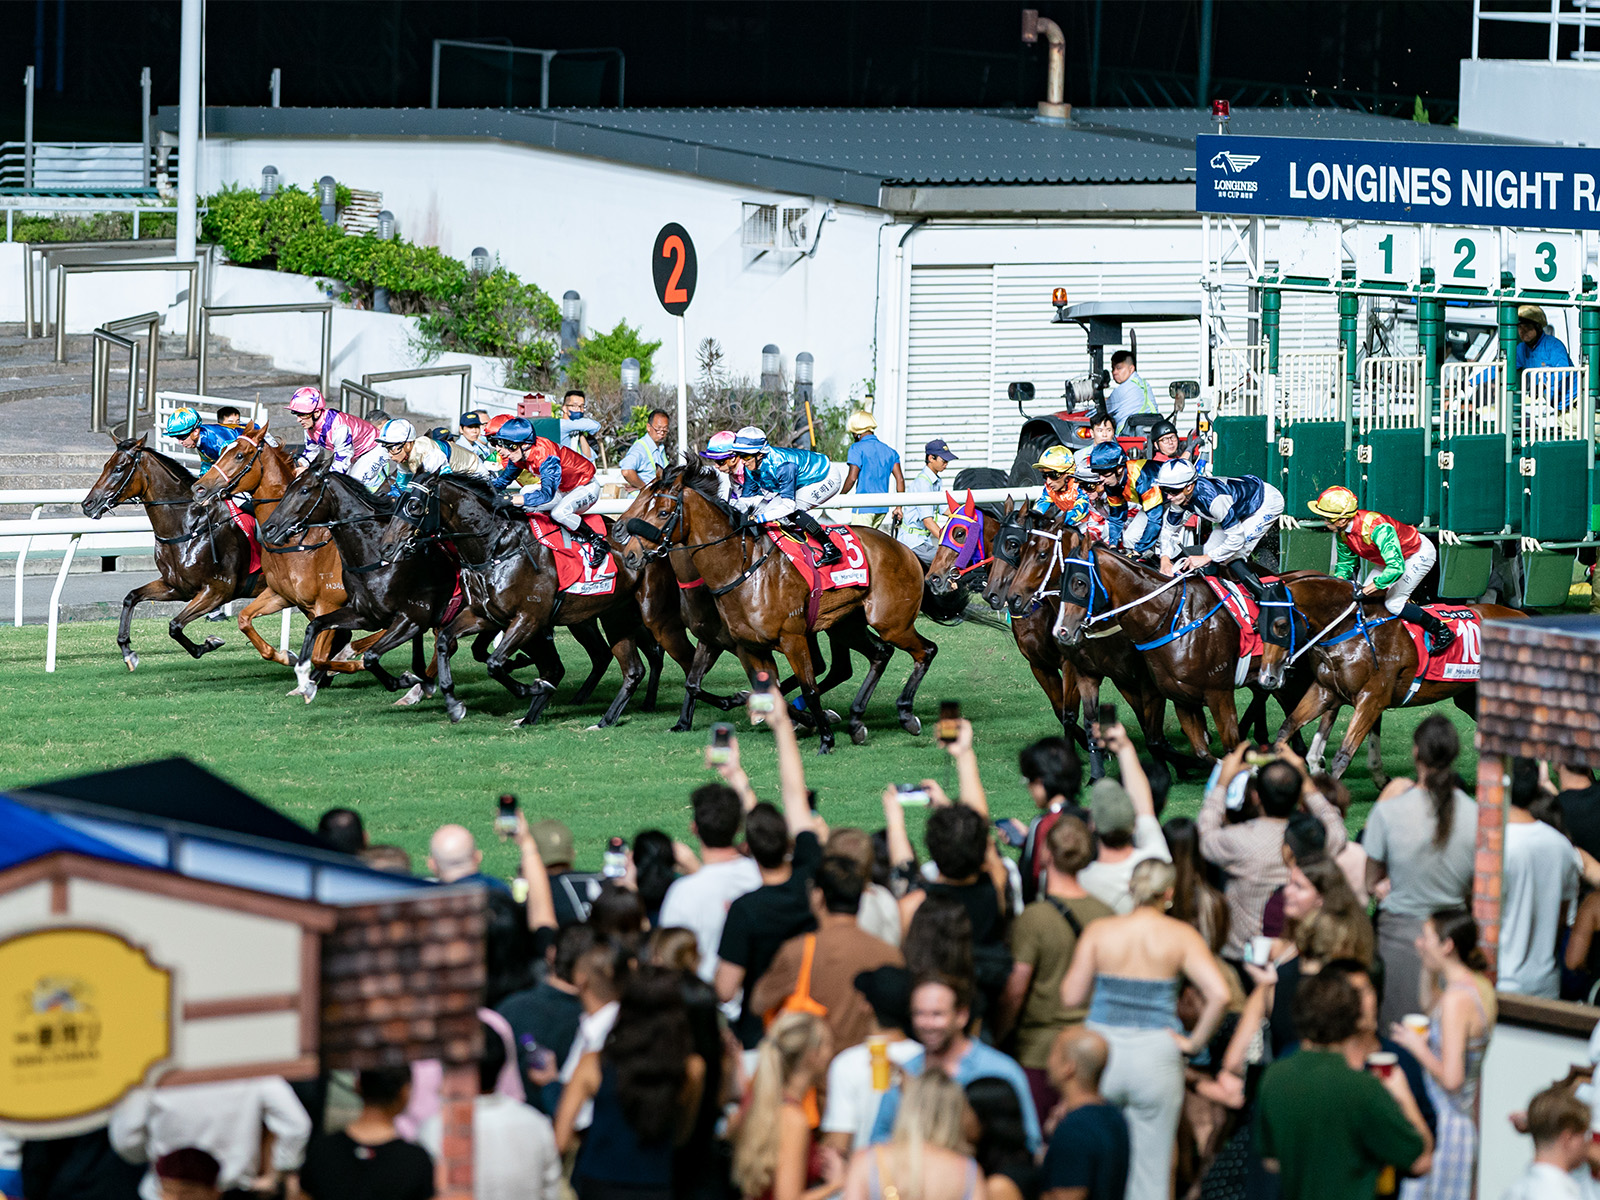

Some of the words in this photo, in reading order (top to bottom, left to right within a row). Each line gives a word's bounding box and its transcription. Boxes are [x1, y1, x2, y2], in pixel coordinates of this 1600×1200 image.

[1214, 179, 1258, 192] LONGINES
[1227, 190, 1240, 199] CUP
[1289, 162, 1451, 206] LONGINES
[1462, 169, 1564, 210] NIGHT
[662, 234, 688, 304] 2
[1378, 233, 1393, 275] 1
[1453, 237, 1477, 279] 2
[1534, 241, 1558, 283] 3
[840, 534, 864, 569] 5
[1456, 619, 1481, 663] 10
